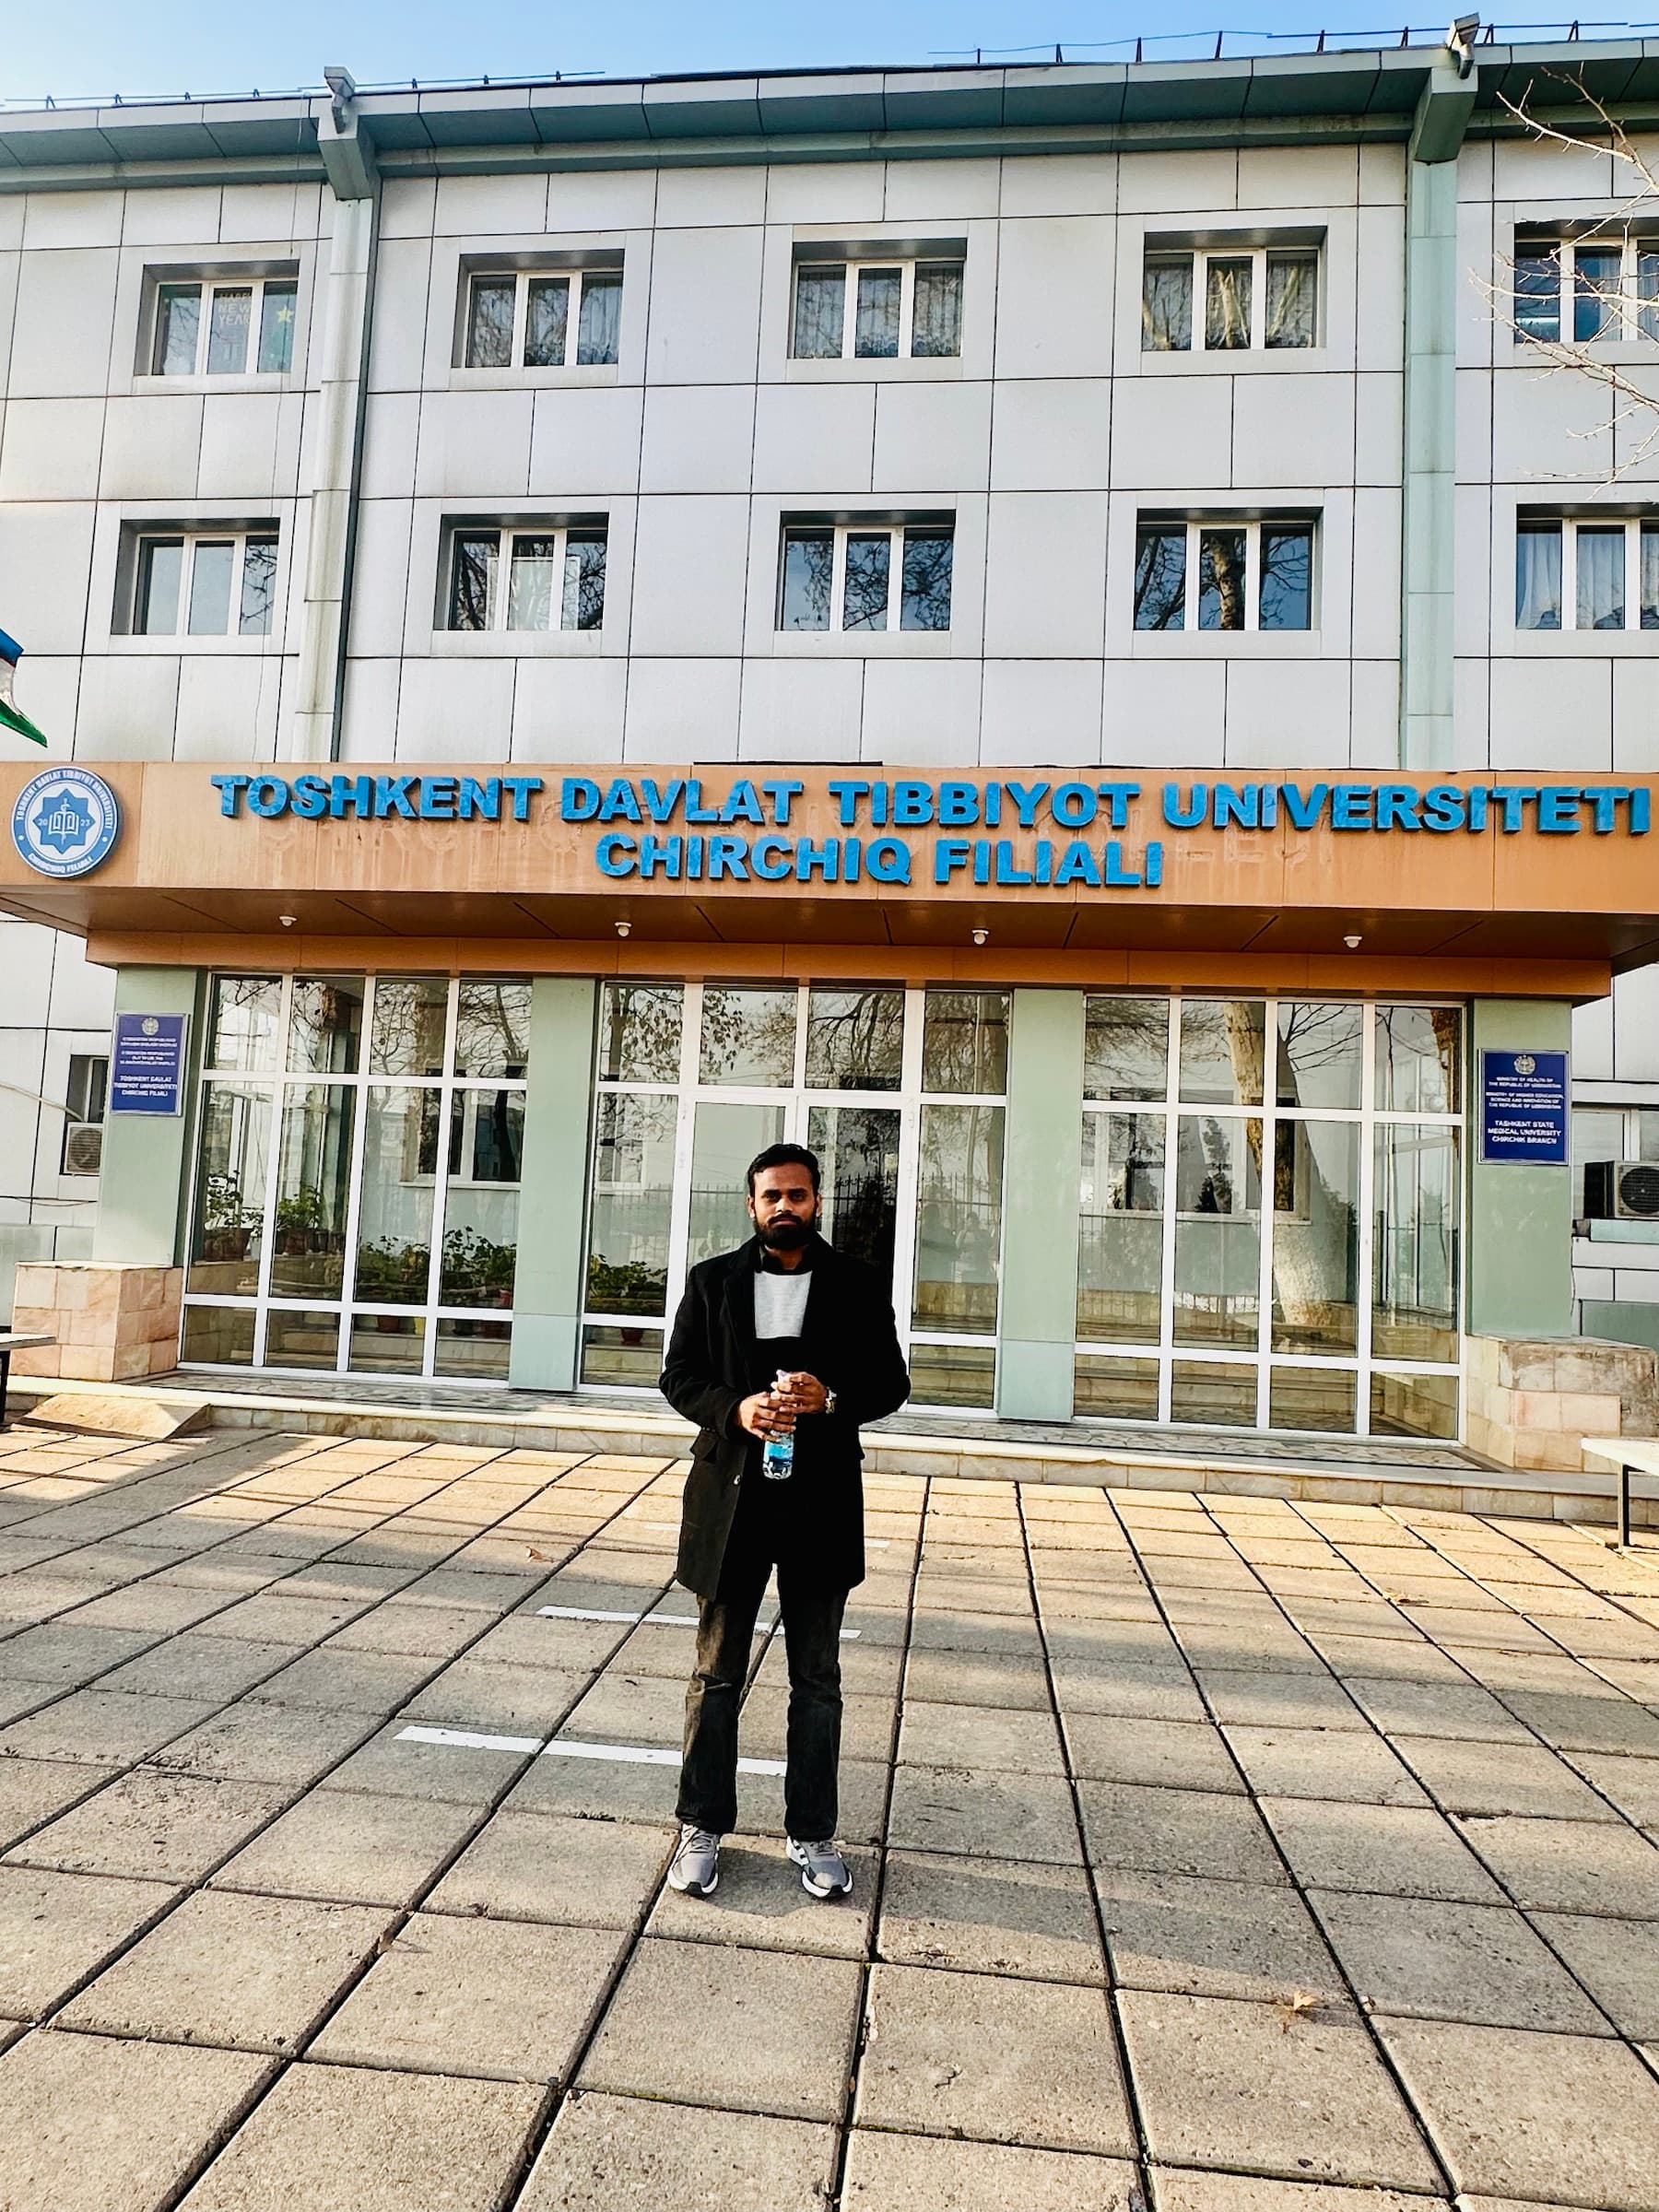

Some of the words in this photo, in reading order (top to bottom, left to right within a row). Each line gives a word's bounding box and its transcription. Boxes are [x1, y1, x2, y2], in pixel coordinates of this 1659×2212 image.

[211, 774, 545, 822] TOSHKENT
[561, 777, 804, 826] DAVLAT
[829, 781, 1140, 830] TIBBIYOT
[1162, 782, 1651, 834] UNIVERSITETI
[38, 818, 48, 827] 20
[80, 818, 90, 827] 23
[595, 832, 912, 886] CHIRCHIQ
[935, 839, 1164, 887] FILIALI
[1532, 1121, 1555, 1129] STATE
[1487, 1127, 1520, 1135] MEDICAL
